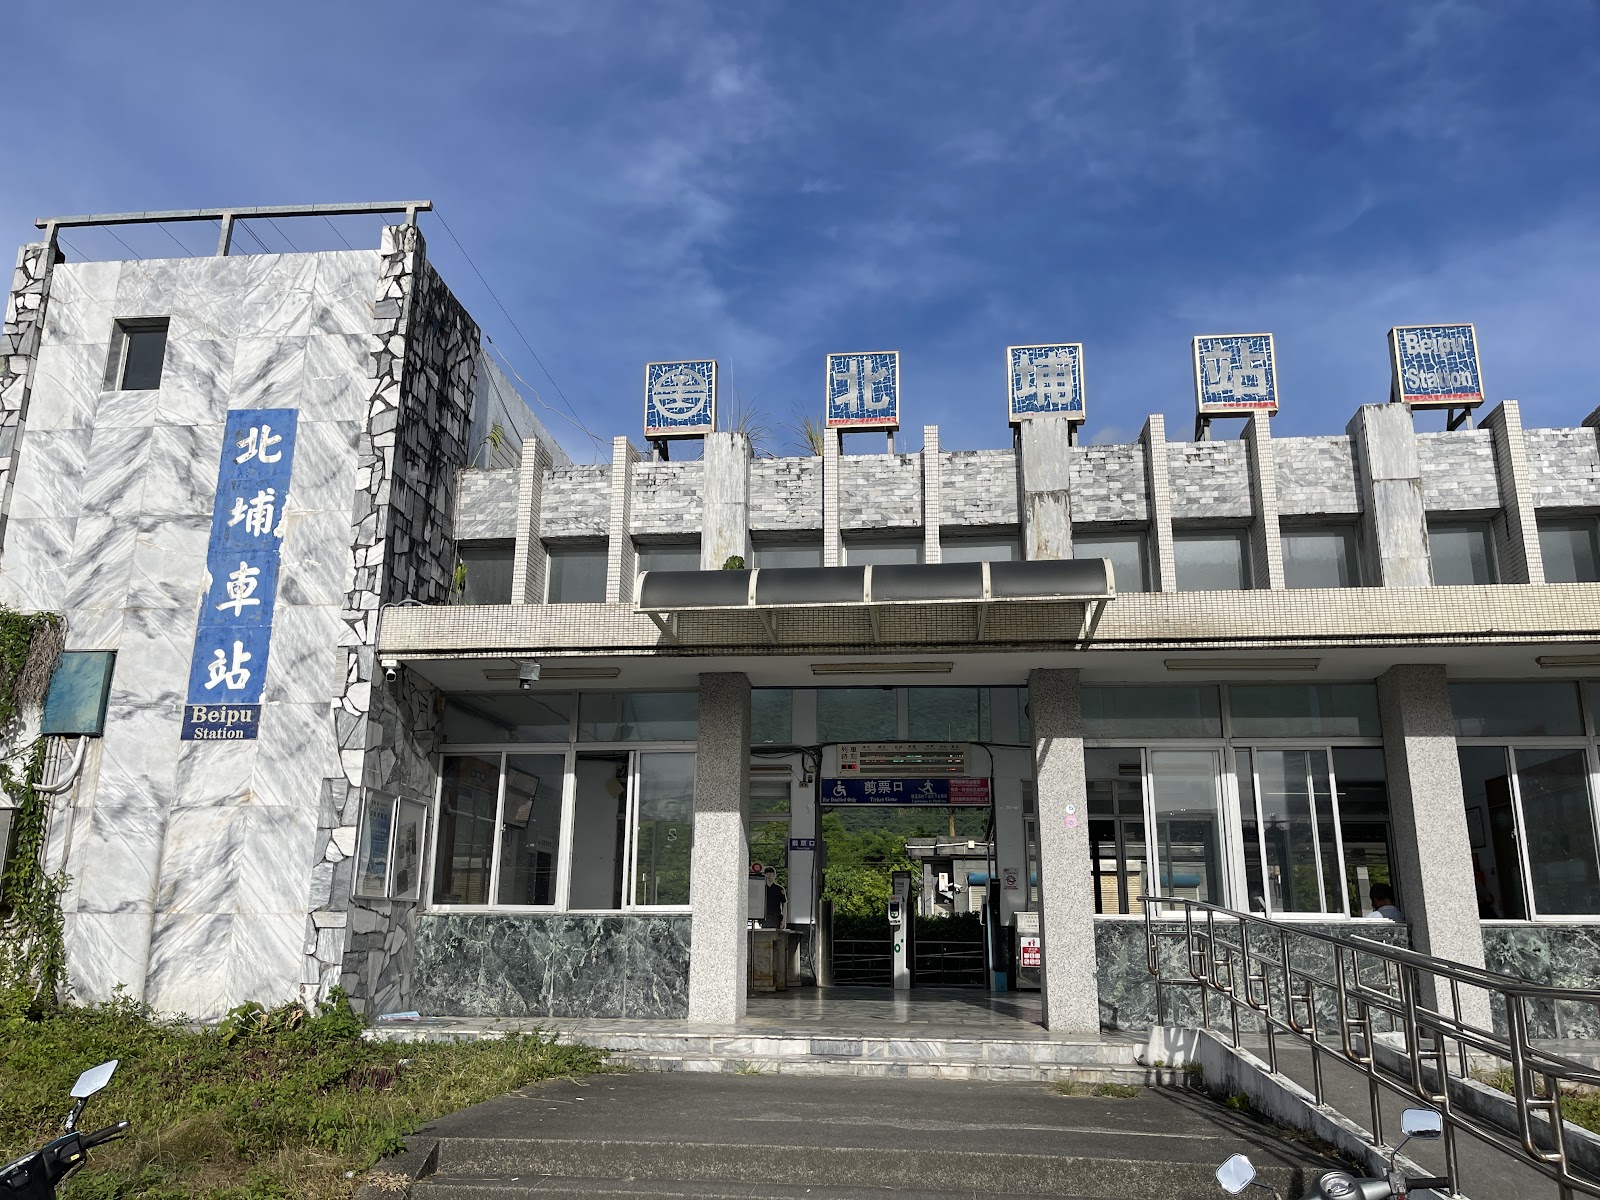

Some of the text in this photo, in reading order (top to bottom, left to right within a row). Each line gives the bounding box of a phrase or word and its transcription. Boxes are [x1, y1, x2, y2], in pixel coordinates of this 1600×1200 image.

[1406, 332, 1464, 357] Beipu
[1015, 351, 1073, 406] 埔
[1204, 341, 1268, 397] 站
[1407, 368, 1473, 390] Station
[834, 358, 889, 411] 北
[204, 424, 283, 690] 北埔車站
[191, 706, 253, 726] Beipu
[193, 727, 244, 740] Station
[864, 780, 904, 795] 剪票口
